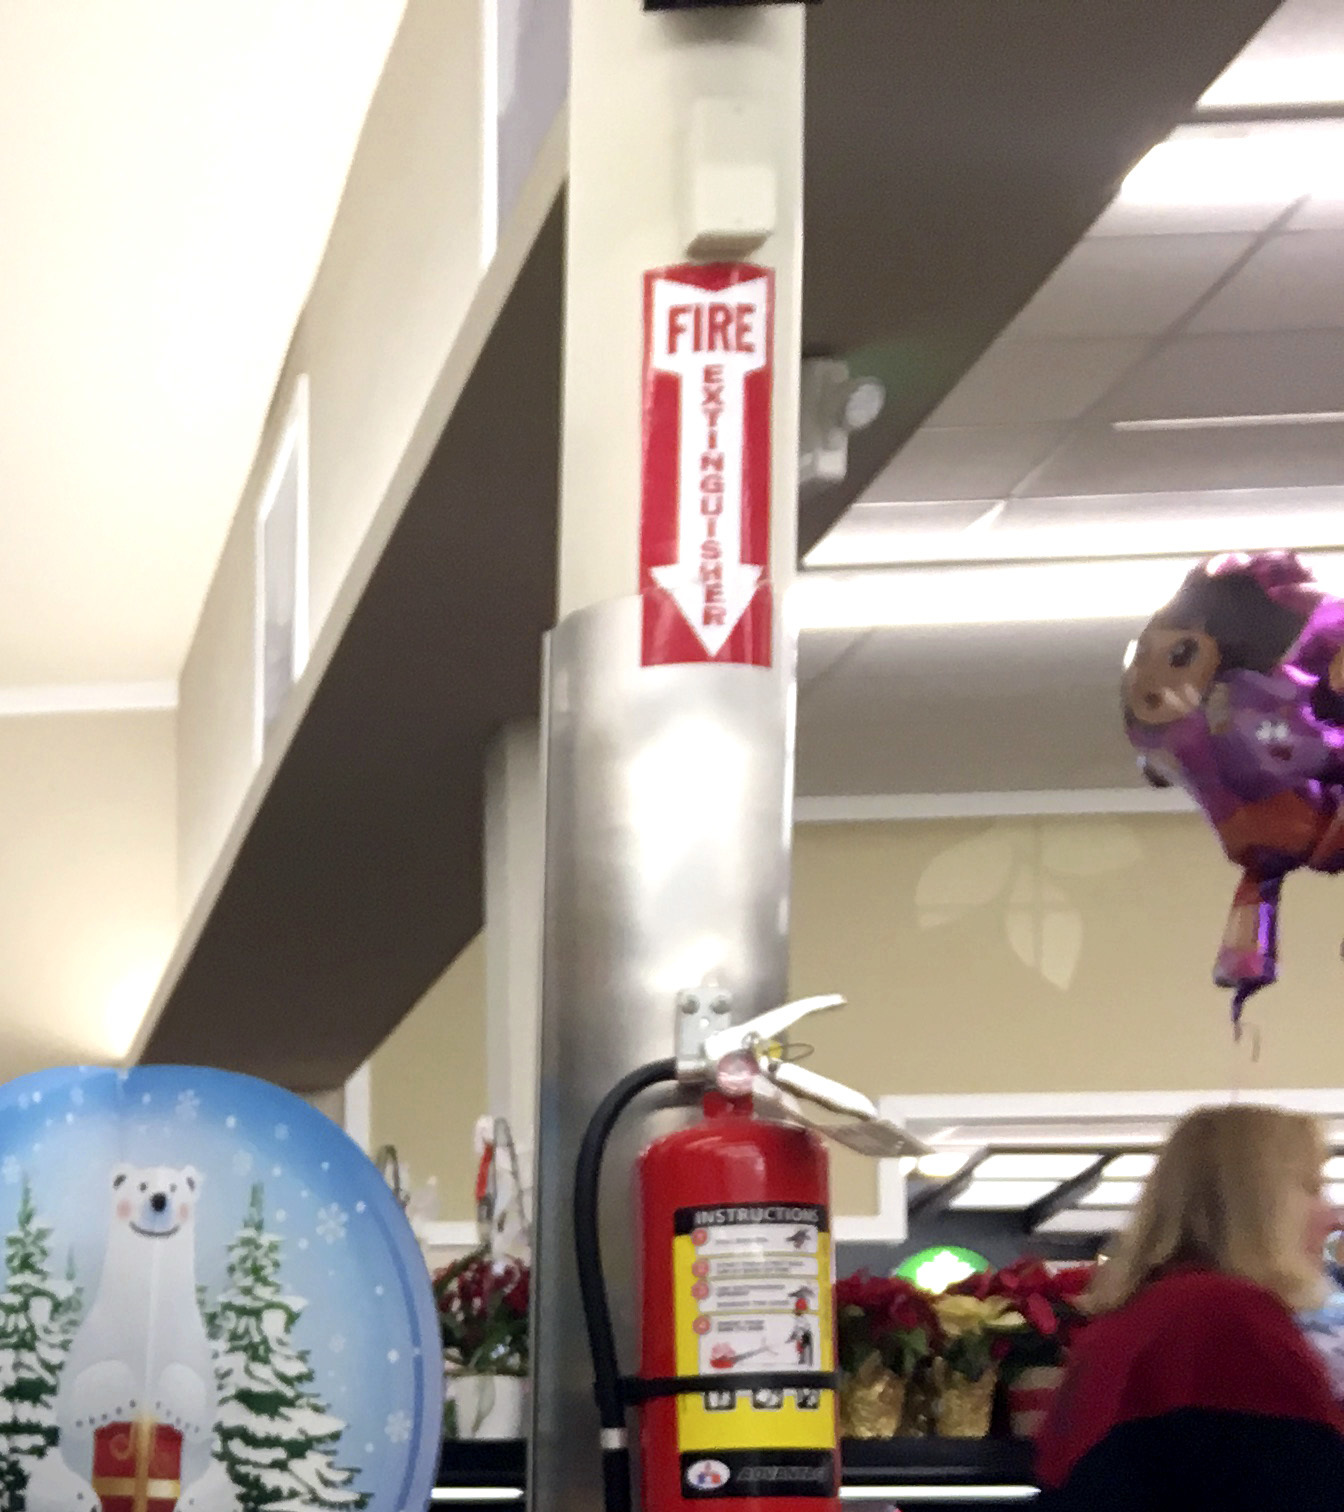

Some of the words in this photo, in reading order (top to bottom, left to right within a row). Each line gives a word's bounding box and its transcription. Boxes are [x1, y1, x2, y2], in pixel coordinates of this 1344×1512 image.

[667, 303, 758, 355] FIRE
[701, 364, 725, 627] EXTINGUISHER
[694, 1206, 820, 1225] INSTRUCTIONS
